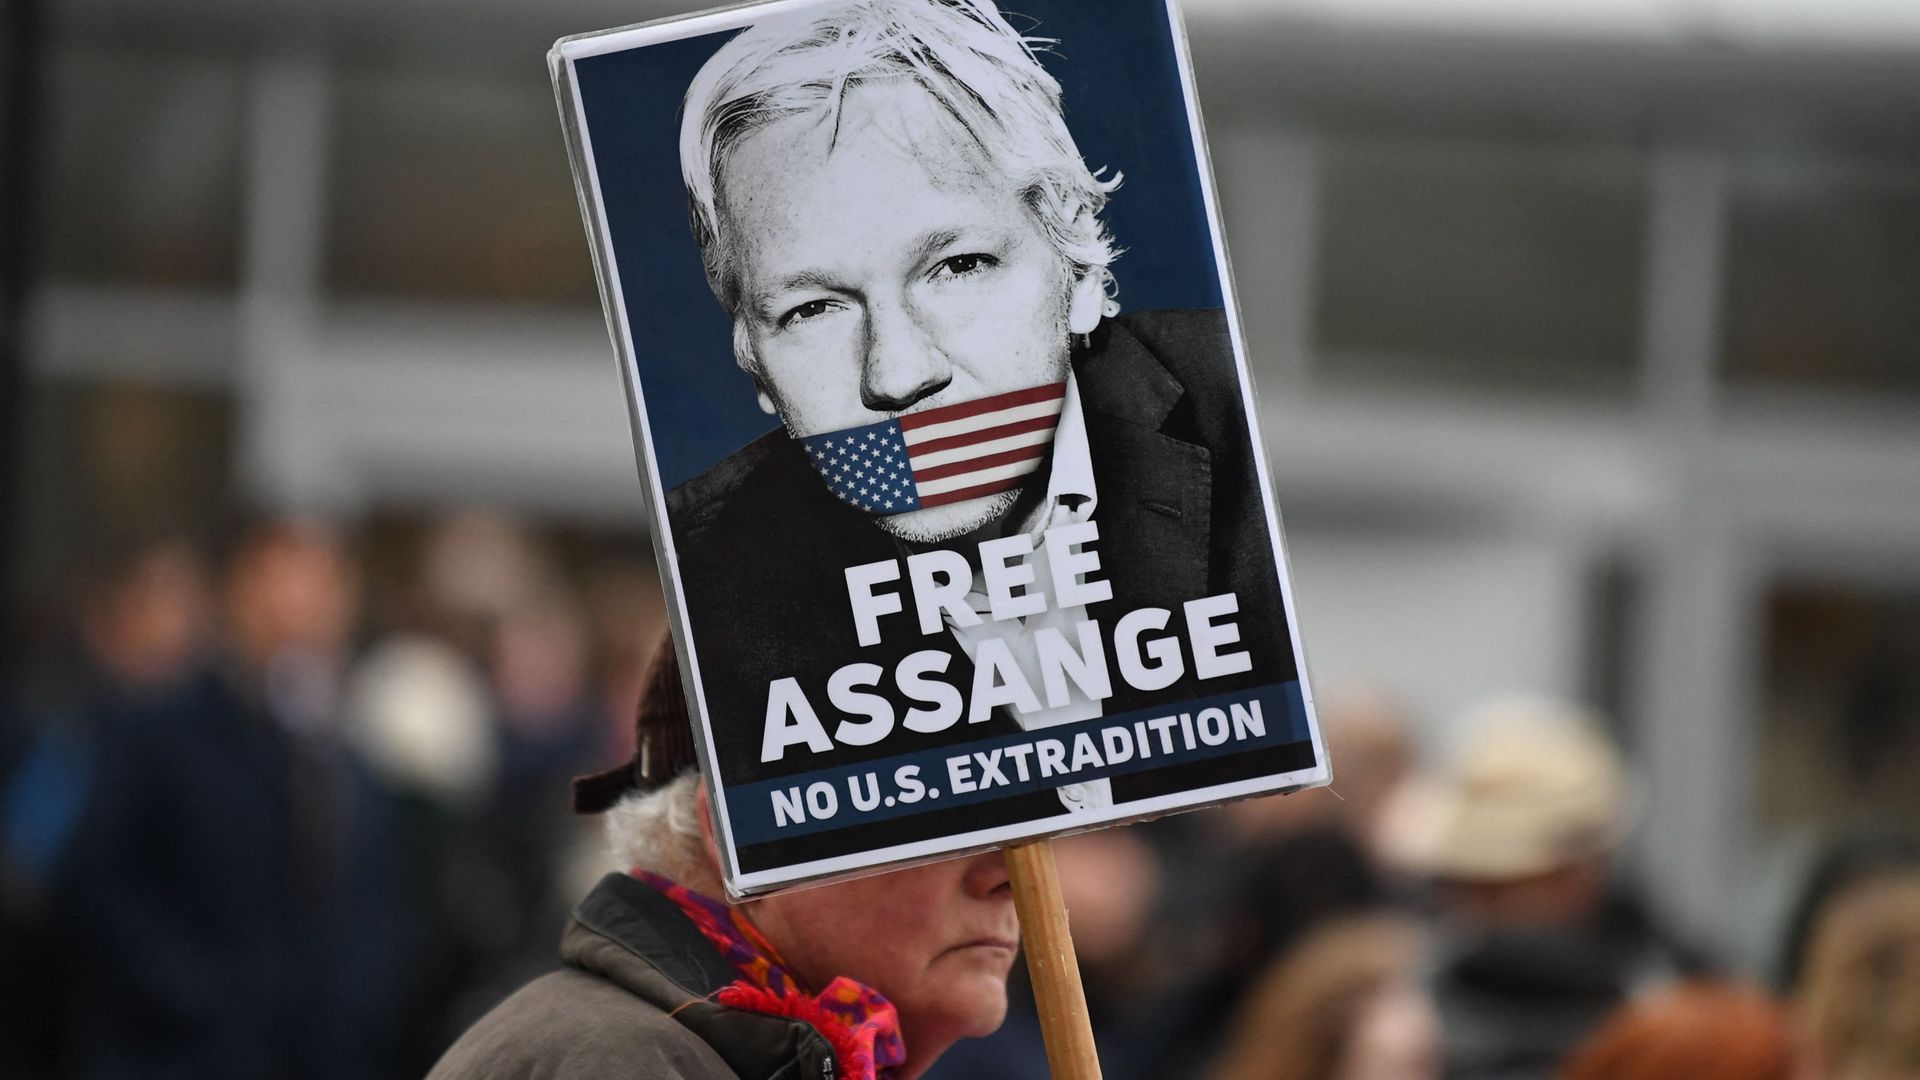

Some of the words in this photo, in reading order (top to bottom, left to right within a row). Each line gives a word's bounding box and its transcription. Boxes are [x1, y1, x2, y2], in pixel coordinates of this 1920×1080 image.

[844, 520, 1113, 648] FREE
[760, 592, 1253, 763] ASSANGE
[770, 781, 838, 828] NO
[846, 765, 940, 813] U.S.
[946, 700, 1267, 796] EXTRADITION
